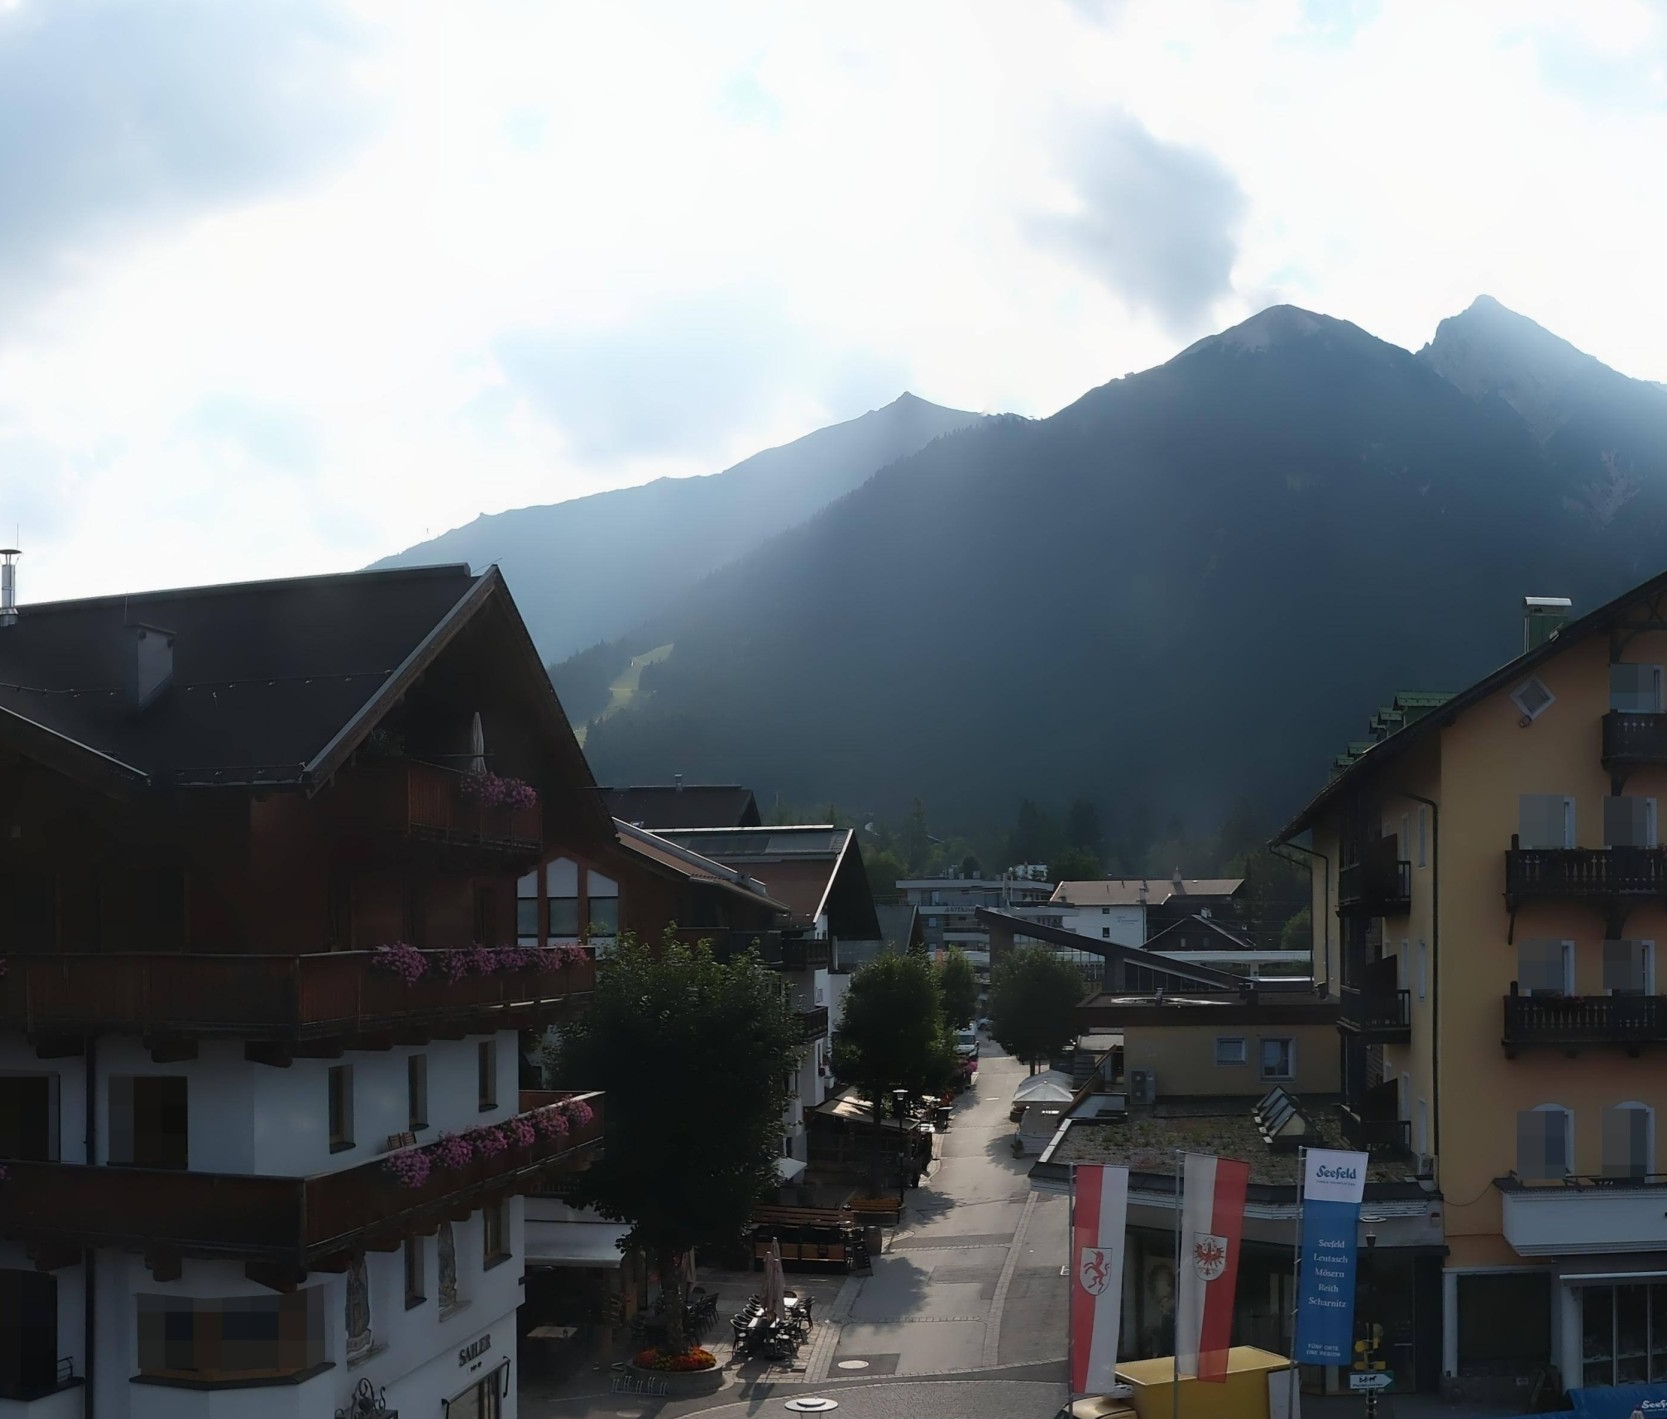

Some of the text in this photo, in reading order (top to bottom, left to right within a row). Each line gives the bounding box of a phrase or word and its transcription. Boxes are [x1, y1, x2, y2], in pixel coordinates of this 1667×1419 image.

[1316, 1165, 1357, 1180] Seefeld
[1318, 1239, 1345, 1249] Seefeld
[1313, 1253, 1348, 1264] Leutasch
[1315, 1268, 1345, 1278] Mösern
[1318, 1283, 1339, 1293] Reith
[1308, 1296, 1347, 1308] Scharnitz
[459, 1334, 492, 1367] SAILER
